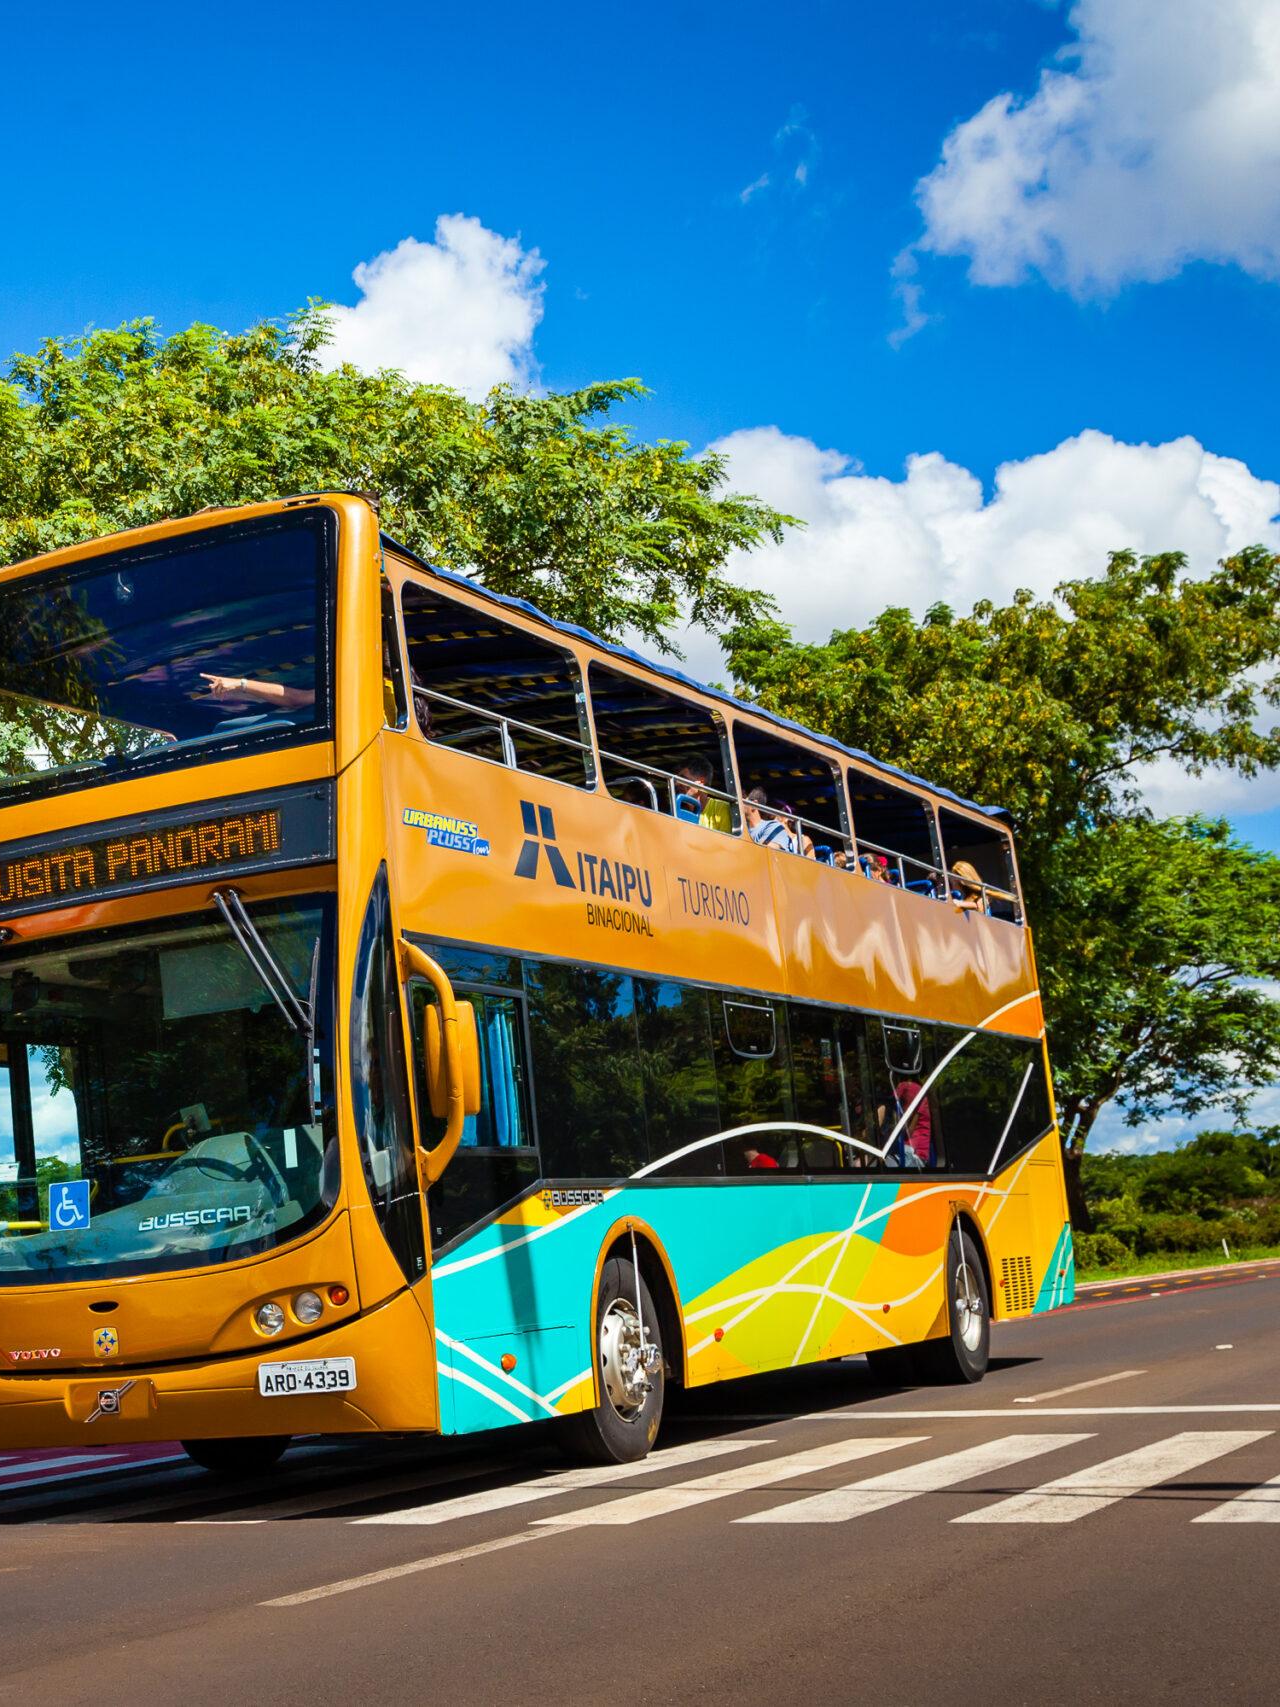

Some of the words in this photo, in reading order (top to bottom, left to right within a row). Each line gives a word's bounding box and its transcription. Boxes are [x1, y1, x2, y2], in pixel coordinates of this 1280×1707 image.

[403, 809, 478, 838] URBANUSS
[107, 813, 279, 880] PANORAMI
[426, 828, 472, 852] PLUSS
[577, 851, 653, 908] ITAIPU
[677, 877, 751, 927] TURISMO
[587, 902, 654, 938] BINACIONAL
[552, 1189, 605, 1206] BUSSCAR
[138, 1205, 252, 1232] BUSSCAR
[9, 1347, 61, 1361] VOLVO
